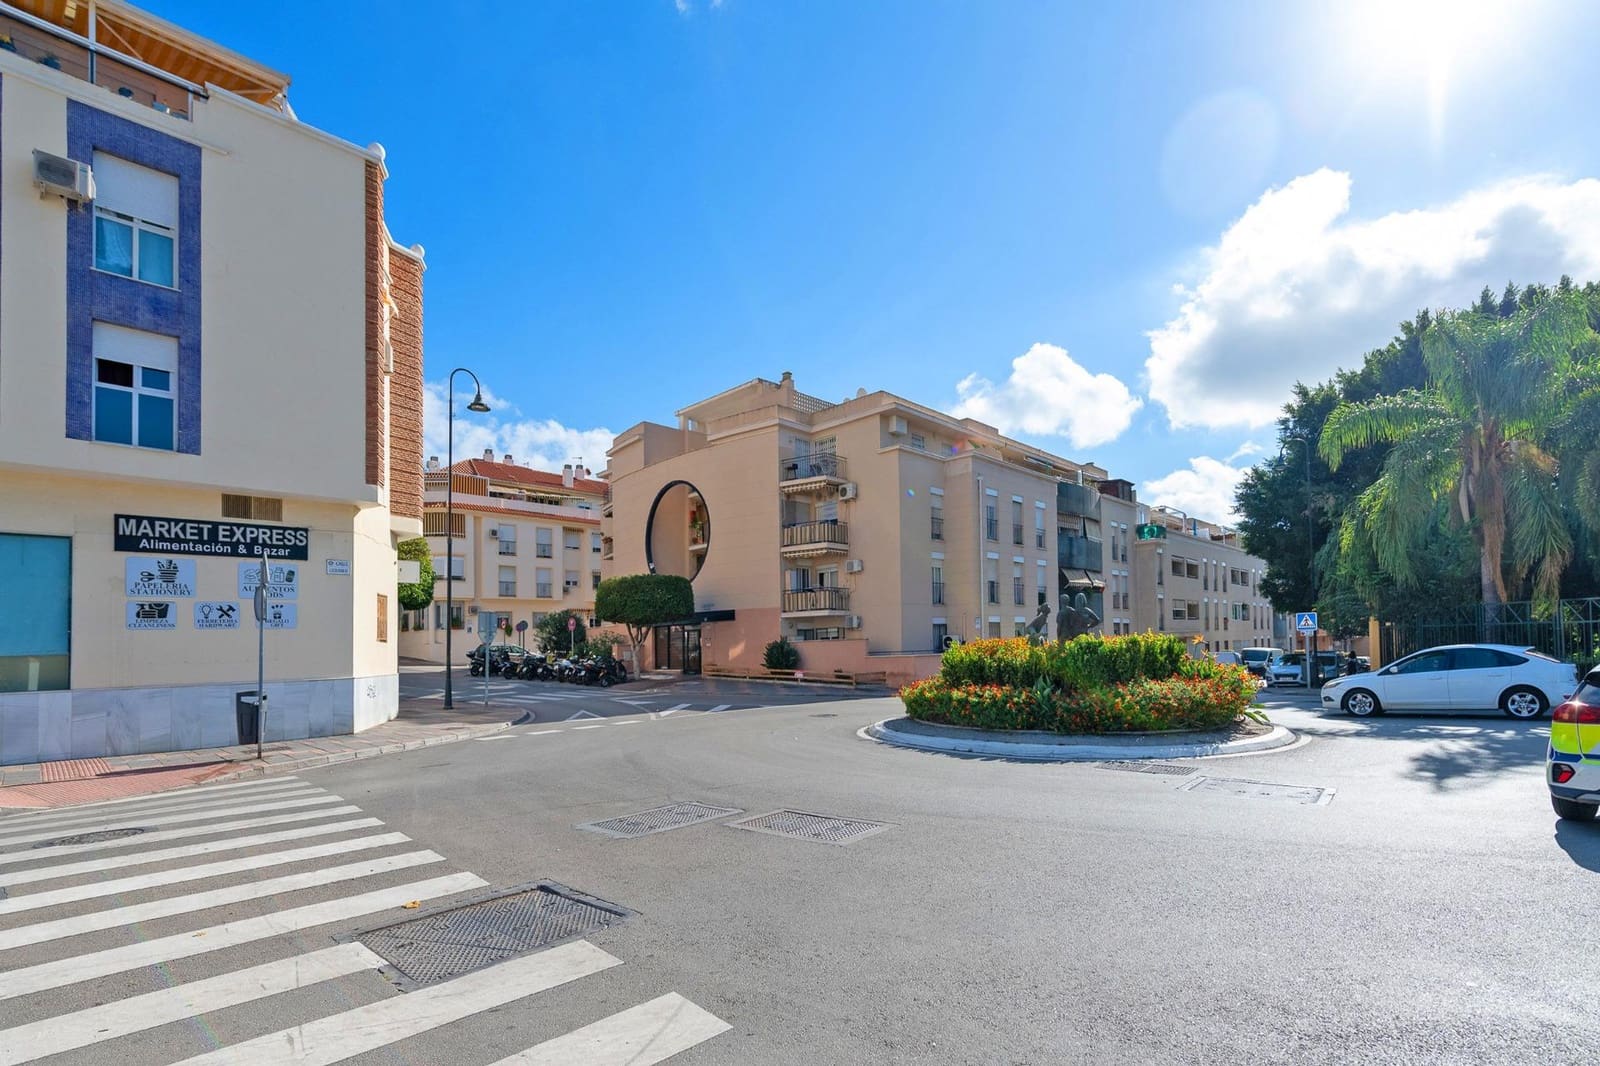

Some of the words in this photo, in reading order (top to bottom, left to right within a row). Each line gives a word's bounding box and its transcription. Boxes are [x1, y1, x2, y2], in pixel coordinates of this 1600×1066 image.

[118, 517, 212, 541] MARKET
[217, 524, 307, 546] EXPRESS
[139, 538, 231, 553] Alimentación
[238, 544, 247, 554] &
[254, 545, 290, 556] Bazar
